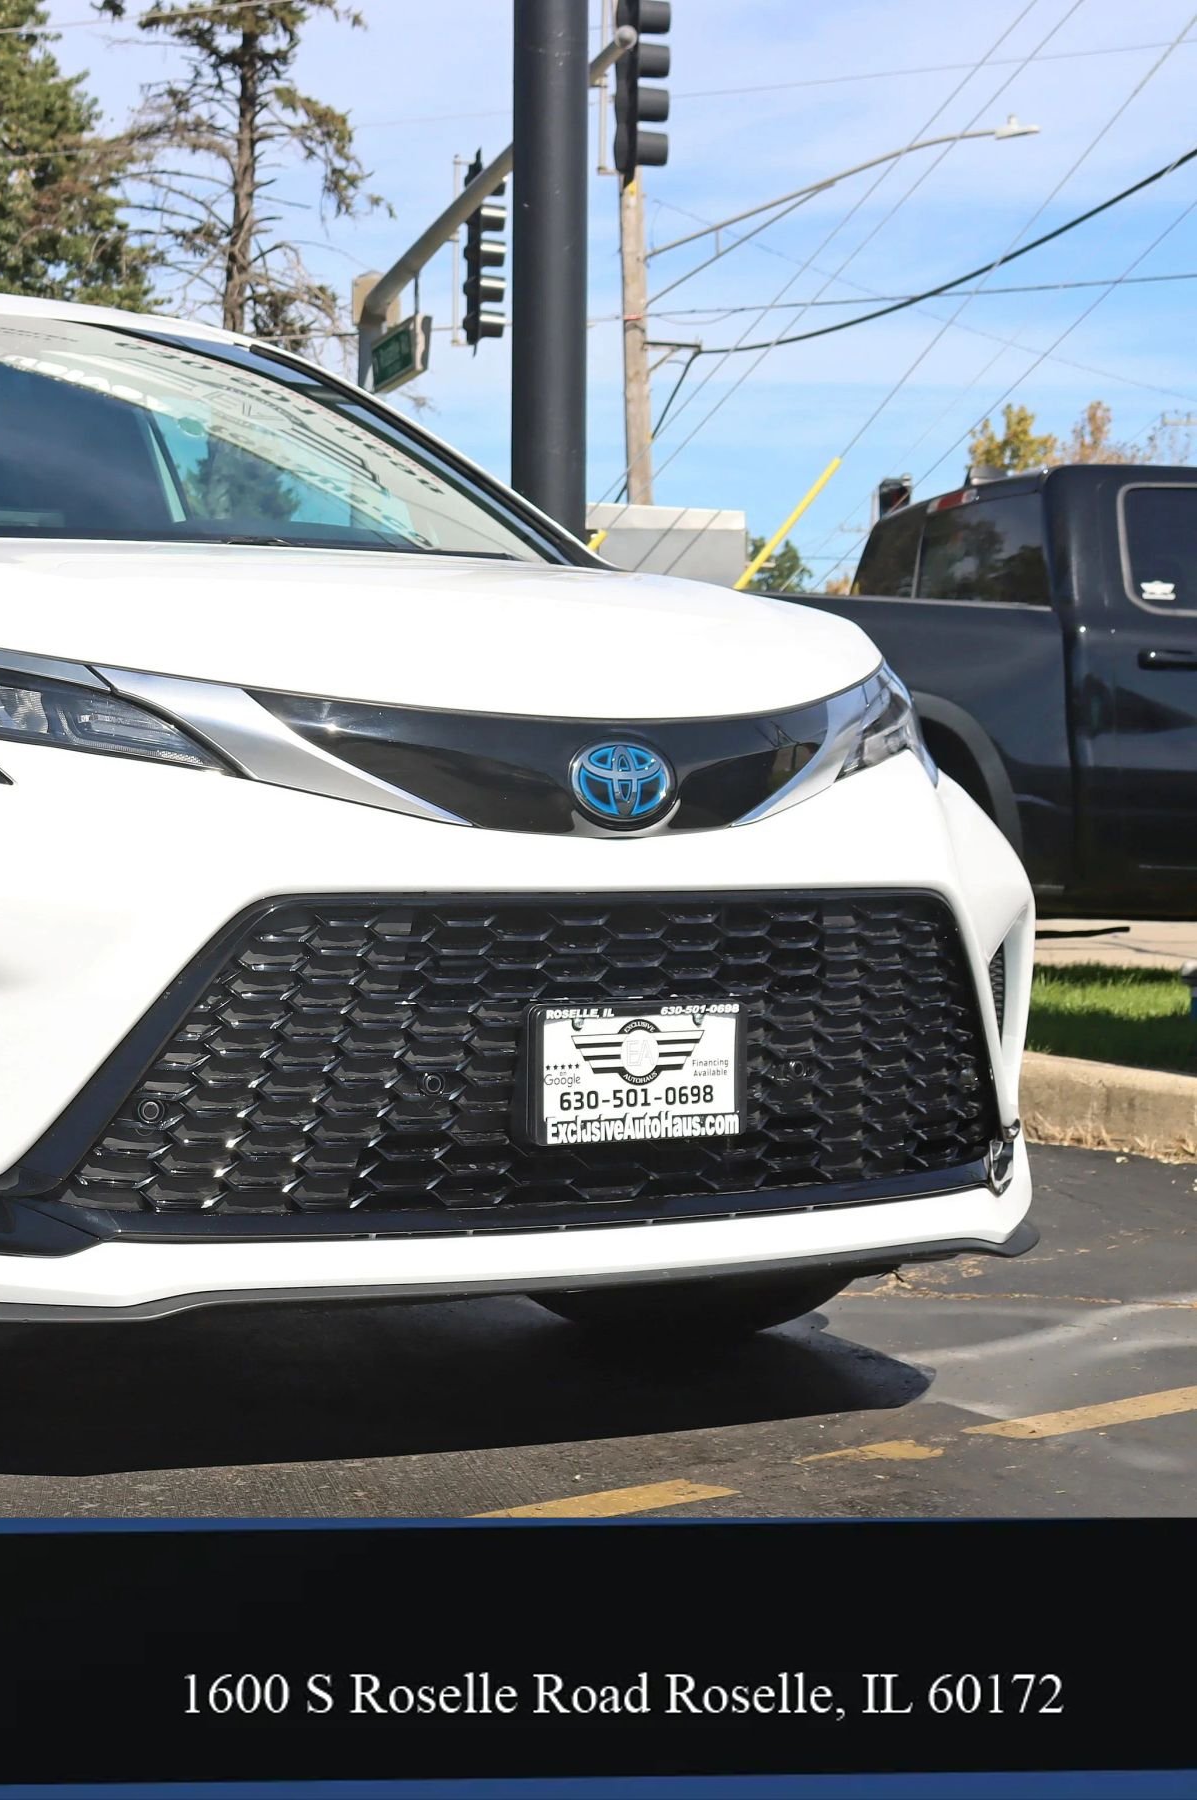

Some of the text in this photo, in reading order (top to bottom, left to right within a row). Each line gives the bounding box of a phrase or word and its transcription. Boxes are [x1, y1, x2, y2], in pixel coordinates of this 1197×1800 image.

[603, 1008, 615, 1017] IL
[661, 1004, 740, 1015] 630-501-0698
[692, 1058, 729, 1067] Financing
[623, 1070, 658, 1084] AUTOHAUS
[693, 1069, 728, 1077] Available
[544, 1073, 581, 1088] Google
[560, 1085, 714, 1111] 630-501-0698
[546, 1112, 740, 1144] ExclusiveAutoHaus.com
